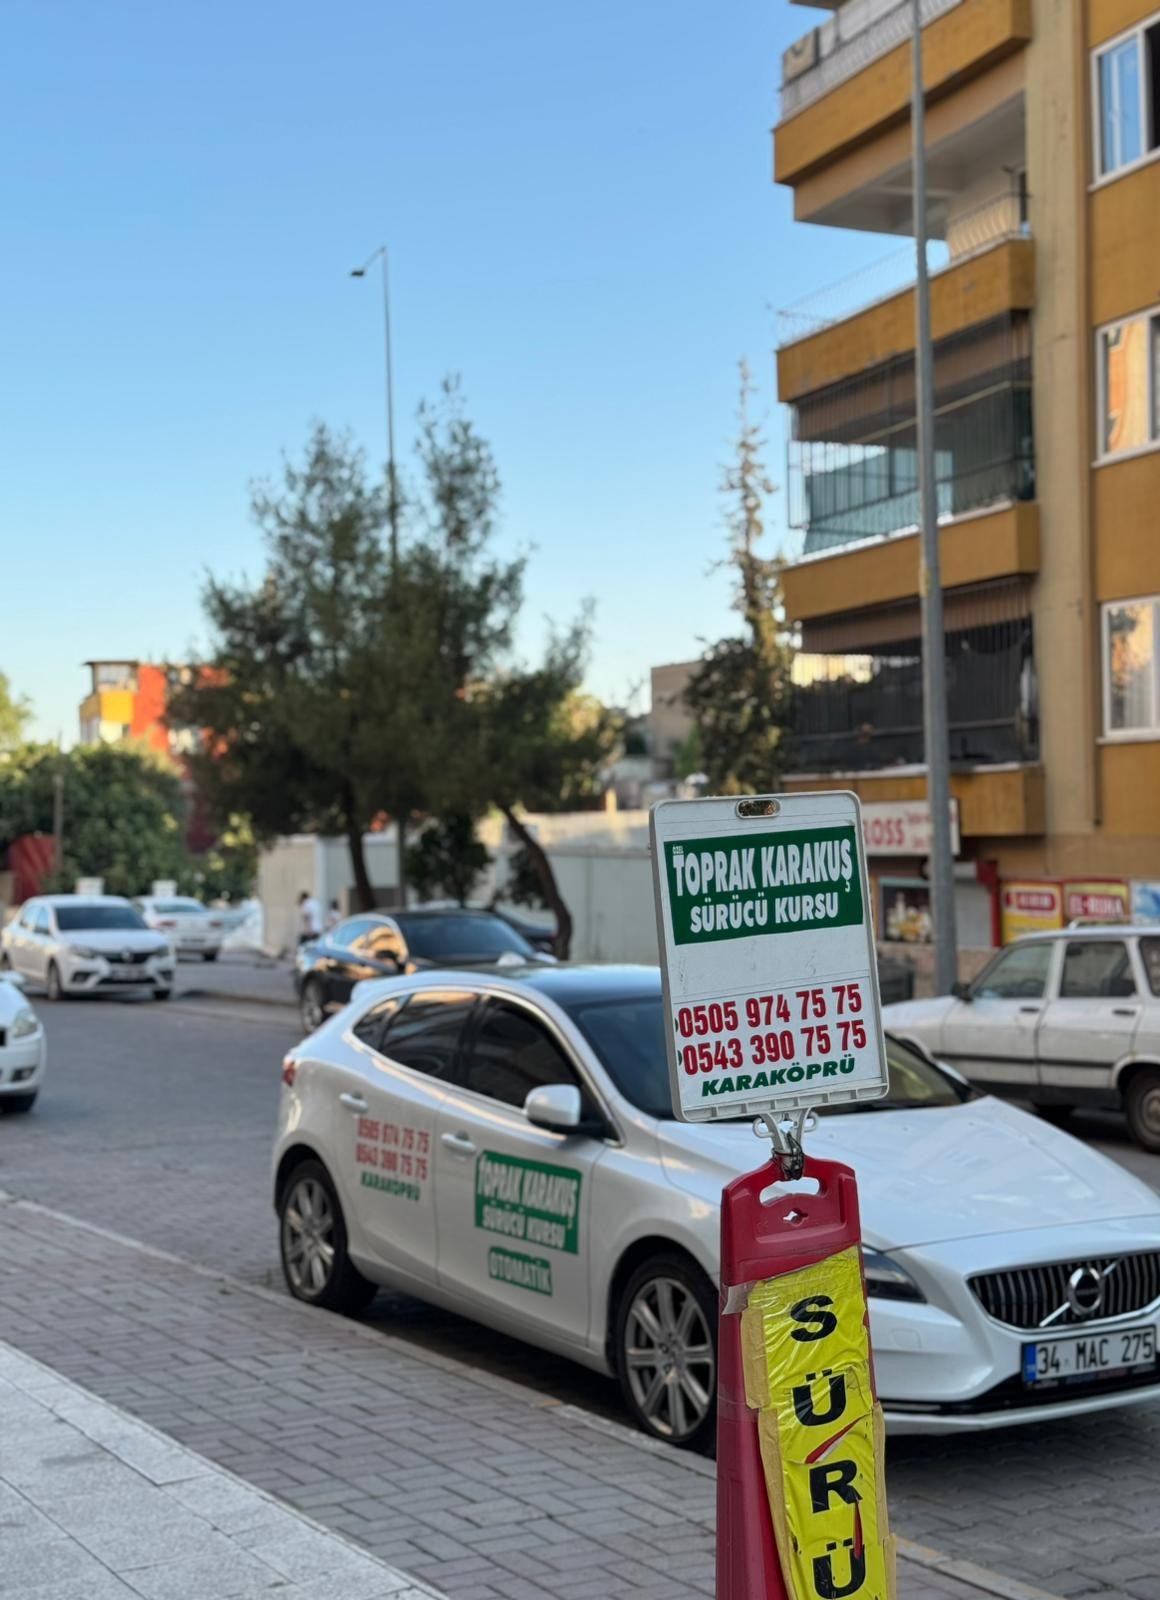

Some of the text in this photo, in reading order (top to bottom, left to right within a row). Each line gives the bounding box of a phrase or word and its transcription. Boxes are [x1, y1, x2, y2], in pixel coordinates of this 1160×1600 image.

[673, 839, 853, 896] TOPRAK KARAKUŞ
[690, 892, 839, 933] SÜRÜCÜ KURSU
[679, 983, 862, 1037] 0505 974 75 75
[683, 1019, 867, 1075] 0543 390 75 75
[702, 1054, 855, 1097] KARAKÖPRÜ
[478, 1154, 523, 1203] TOPRAK
[1038, 1332, 1153, 1374] 34 MAC 275
